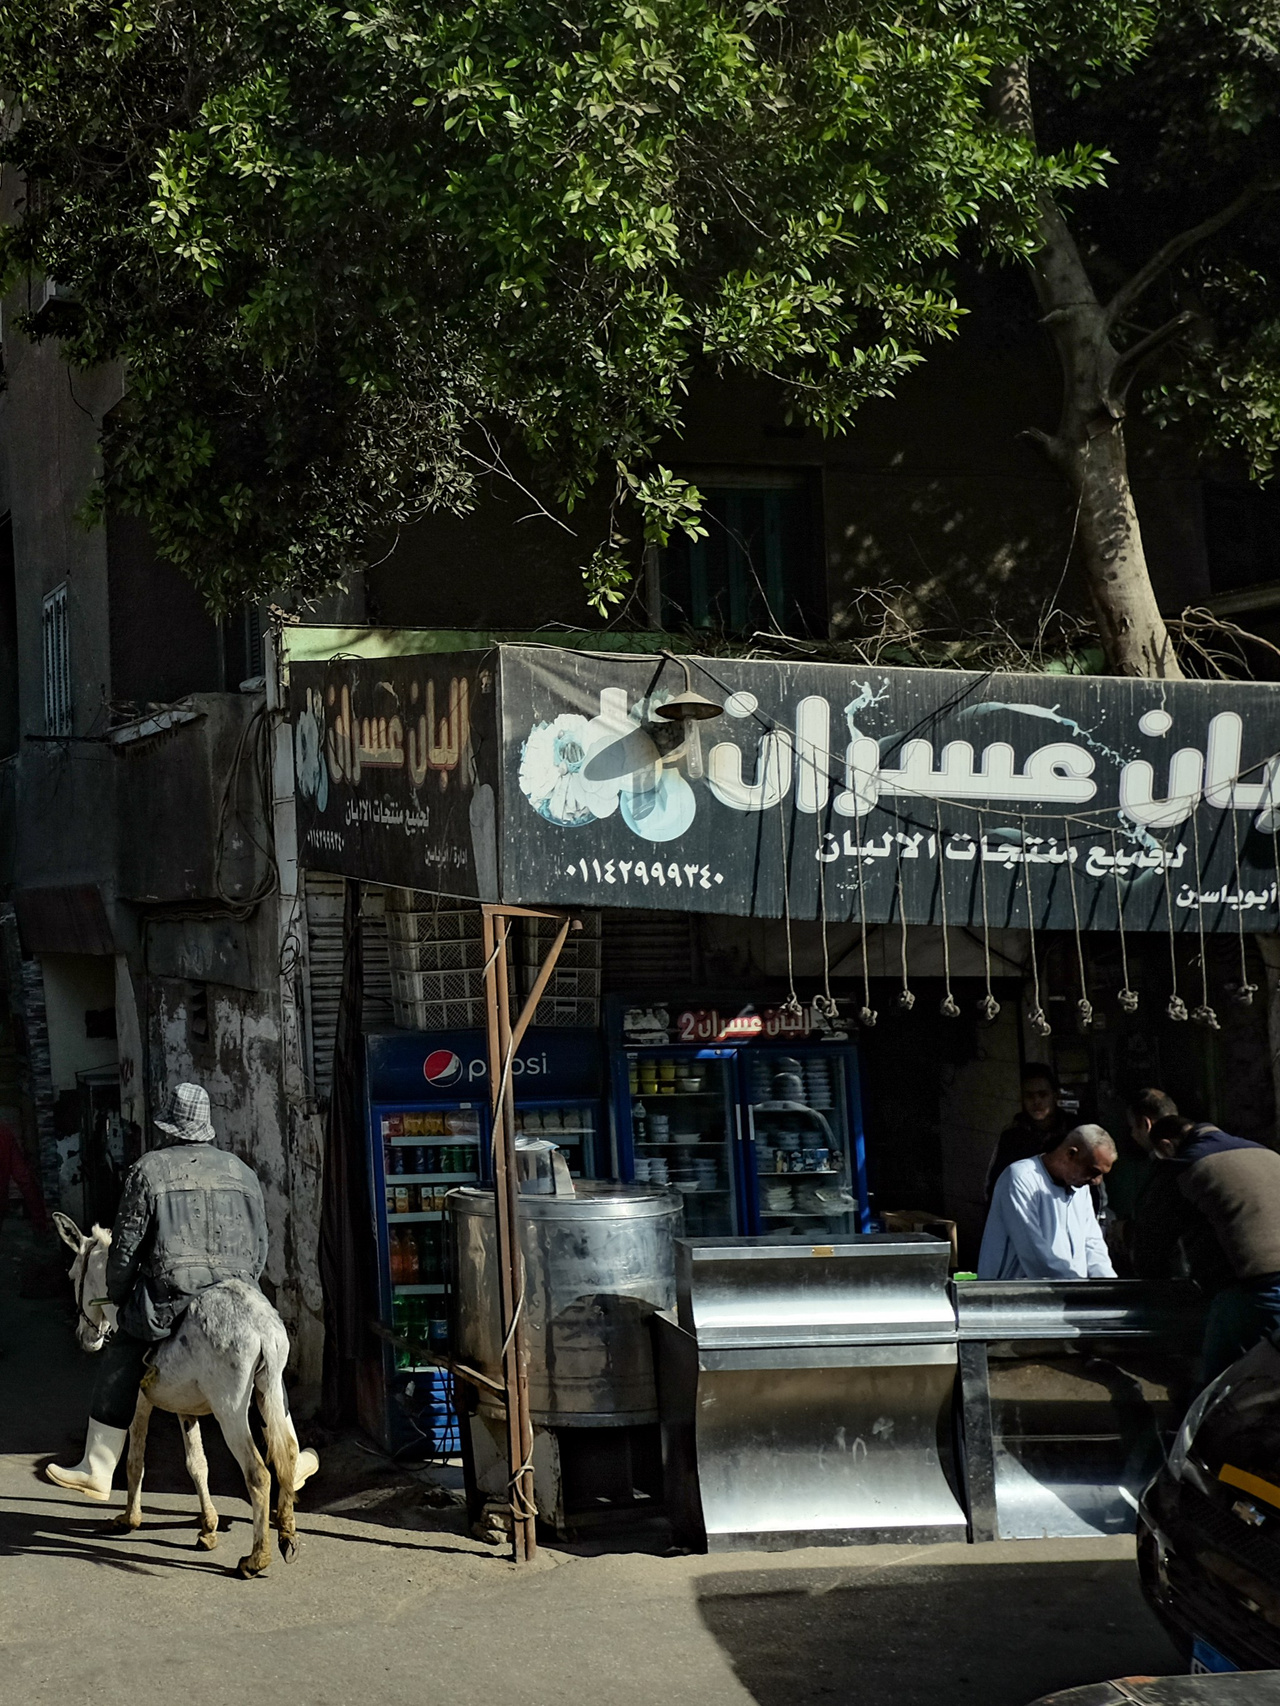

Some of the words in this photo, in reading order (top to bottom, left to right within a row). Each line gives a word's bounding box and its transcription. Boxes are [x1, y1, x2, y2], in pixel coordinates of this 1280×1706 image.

[327, 683, 405, 785] عسران
[708, 691, 1097, 817] عسران
[373, 799, 404, 830] منتجات
[404, 805, 430, 836] لجميع
[945, 833, 1078, 870] منتجات
[1086, 843, 1187, 877] لجميع
[566, 857, 724, 890] ٠١١٤٢٩٩٩٣٤٠
[681, 1013, 695, 1040] 2
[698, 1009, 763, 1040] عسران
[469, 1052, 547, 1082] ppsi
